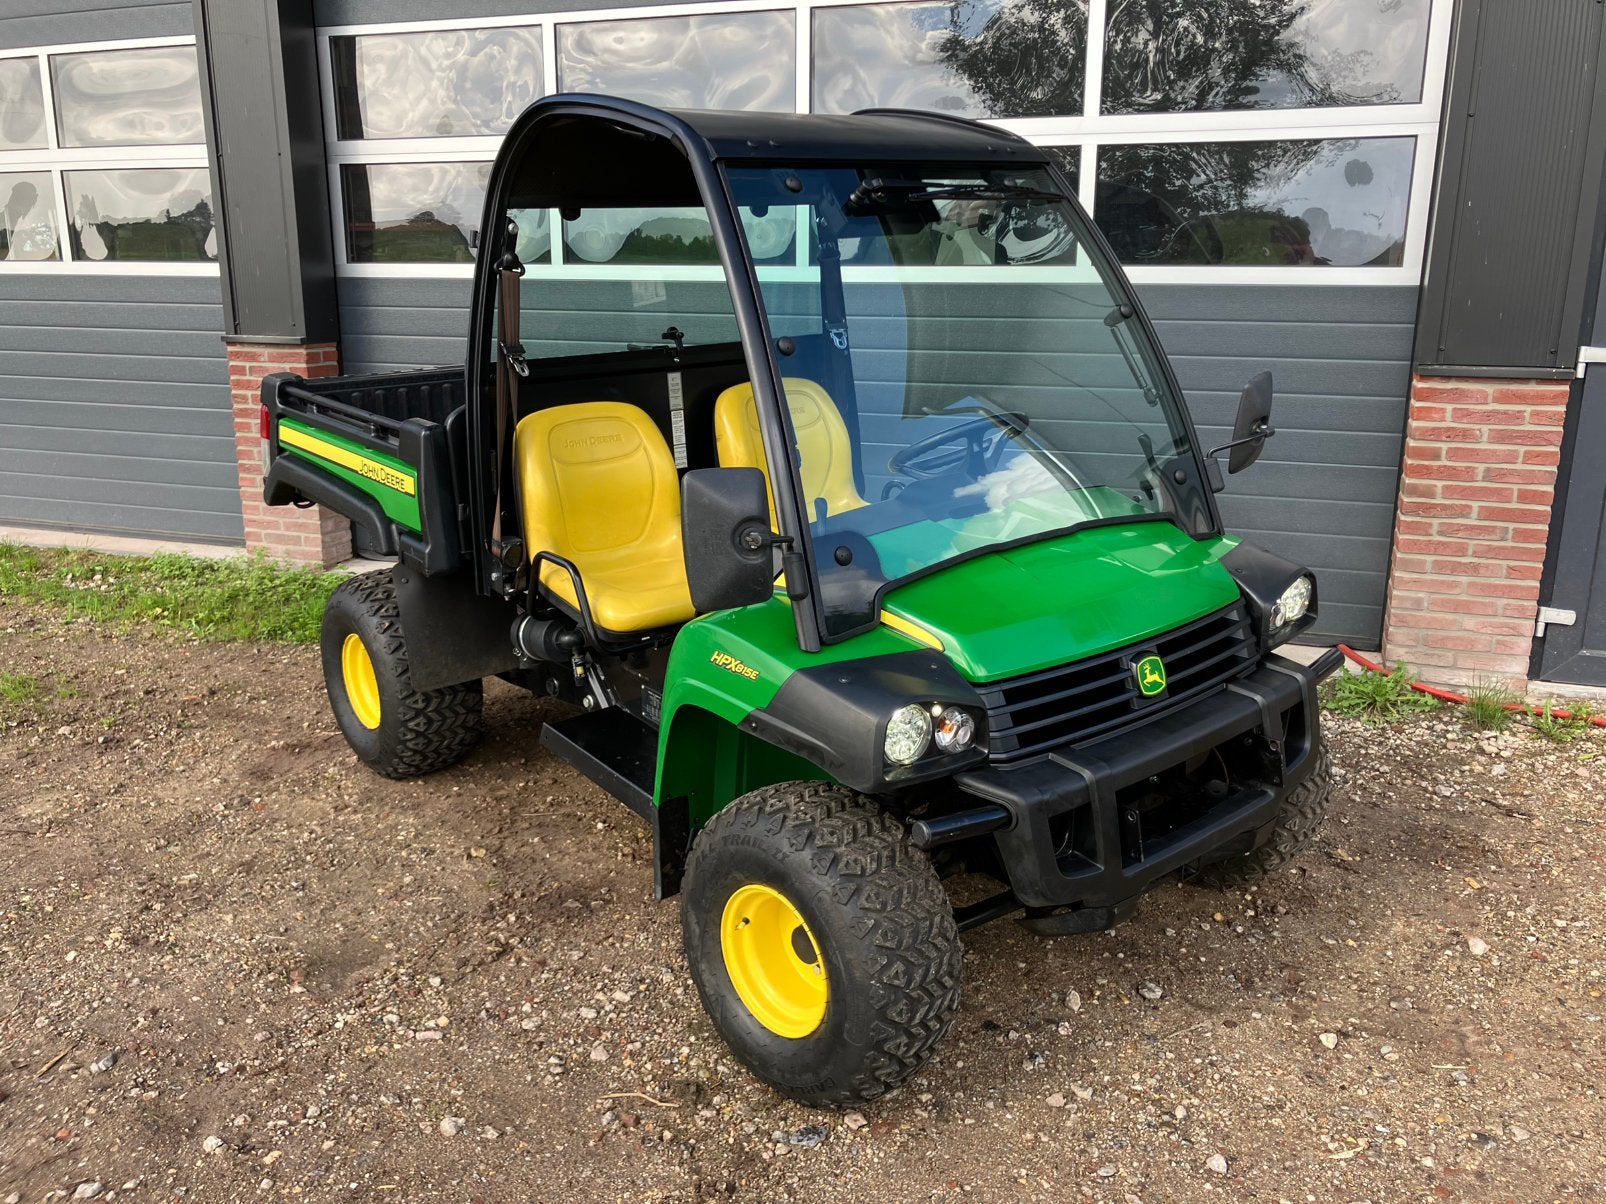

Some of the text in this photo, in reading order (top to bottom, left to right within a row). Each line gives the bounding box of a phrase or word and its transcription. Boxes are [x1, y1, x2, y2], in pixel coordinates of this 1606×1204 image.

[563, 433, 624, 449] JOHN DEERE
[359, 459, 406, 491] JOHN DEERE
[710, 649, 760, 681] HPX815E
[721, 833, 768, 852] TRAIL
